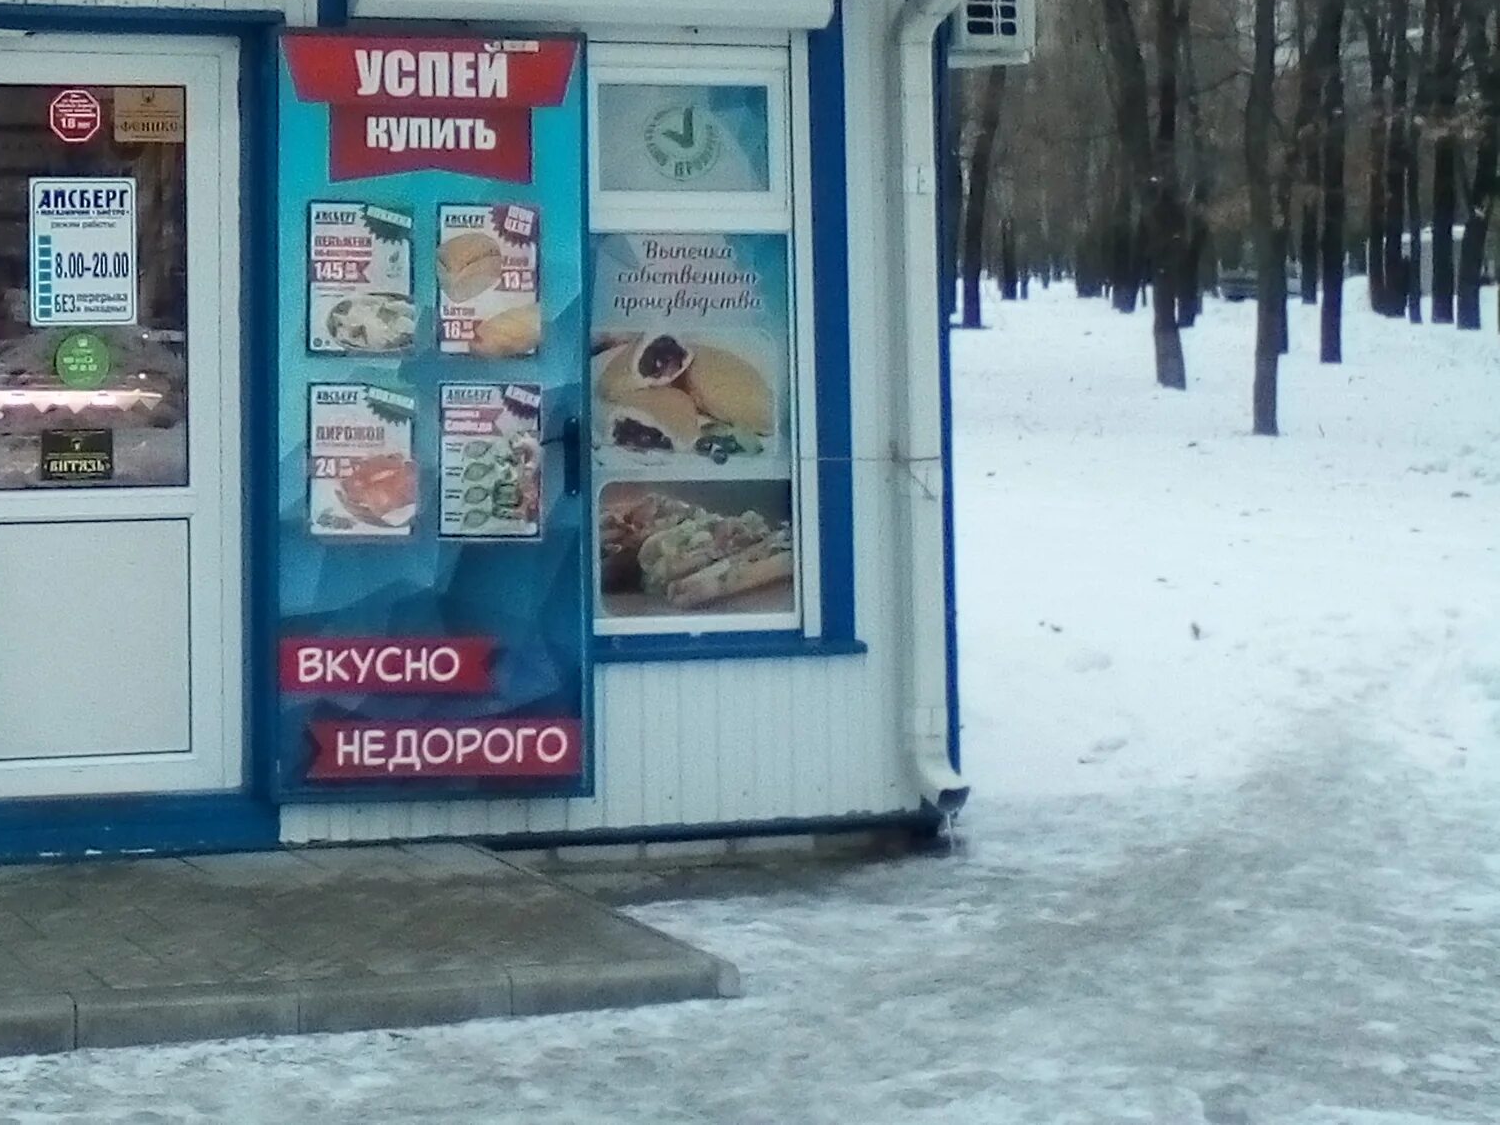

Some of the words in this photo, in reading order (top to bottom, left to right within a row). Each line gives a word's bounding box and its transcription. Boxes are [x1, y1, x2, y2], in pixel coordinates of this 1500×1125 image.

[355, 43, 508, 98] УСПЕЙ
[38, 188, 129, 209] АЙСБЕРГ
[641, 239, 733, 259] Выпечка
[54, 251, 130, 279] 8.00-20.00
[314, 261, 344, 280] 145
[616, 263, 758, 285] собственного
[54, 293, 76, 313] БЕЗ
[613, 289, 763, 316] производства
[49, 459, 106, 473] ВИТЯЗЬ
[315, 457, 337, 477] 24
[297, 646, 461, 684] ВКУСНО
[336, 727, 569, 772] НЕДОРОГО
